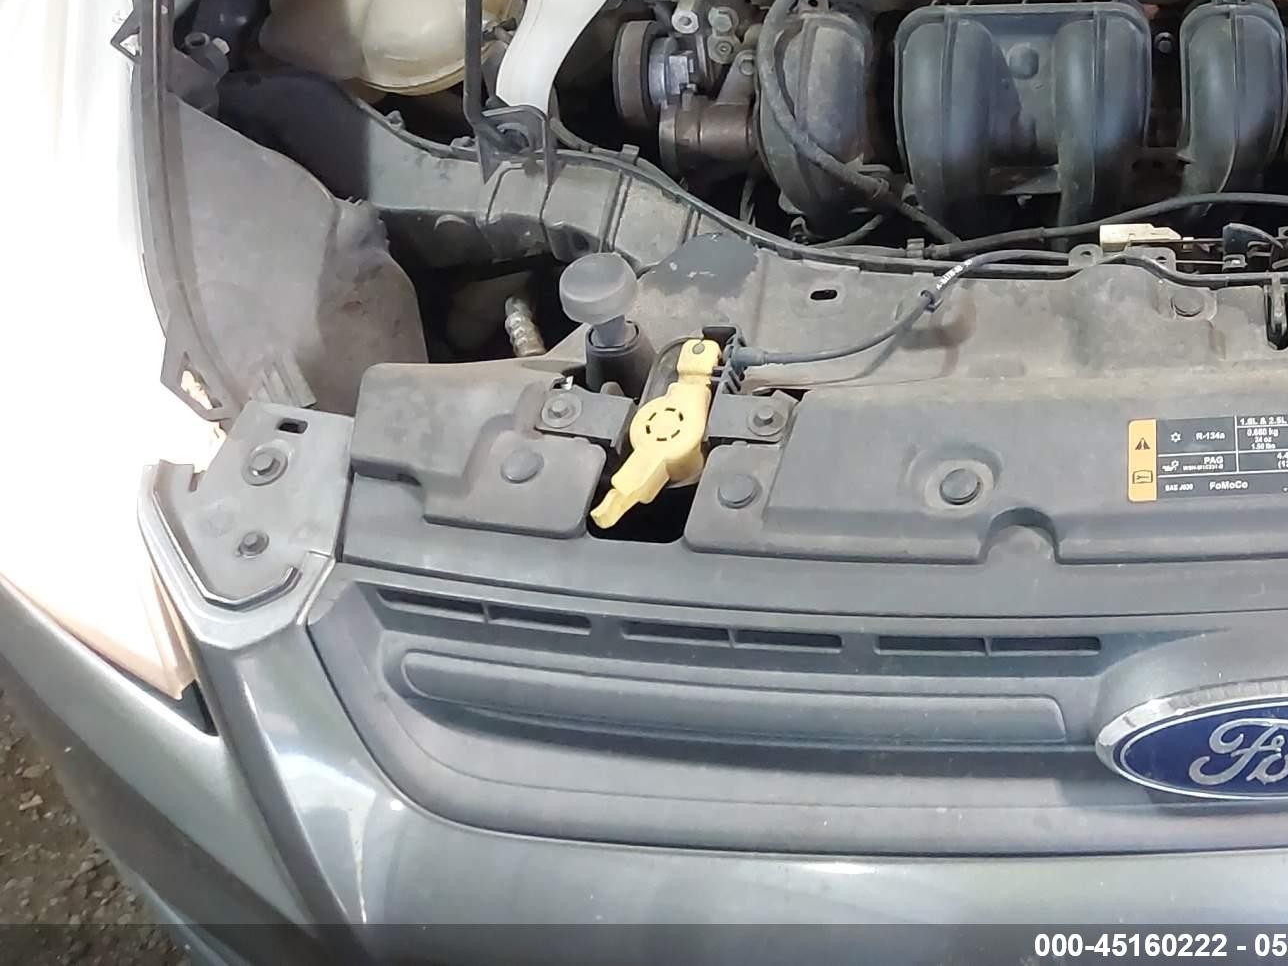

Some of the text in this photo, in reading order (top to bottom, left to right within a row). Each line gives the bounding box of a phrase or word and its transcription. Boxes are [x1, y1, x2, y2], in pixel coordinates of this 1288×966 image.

[1195, 431, 1226, 441] R-134a
[1268, 427, 1279, 437] kg
[1203, 455, 1224, 465] PAG
[1209, 479, 1249, 491] FoMoCo
